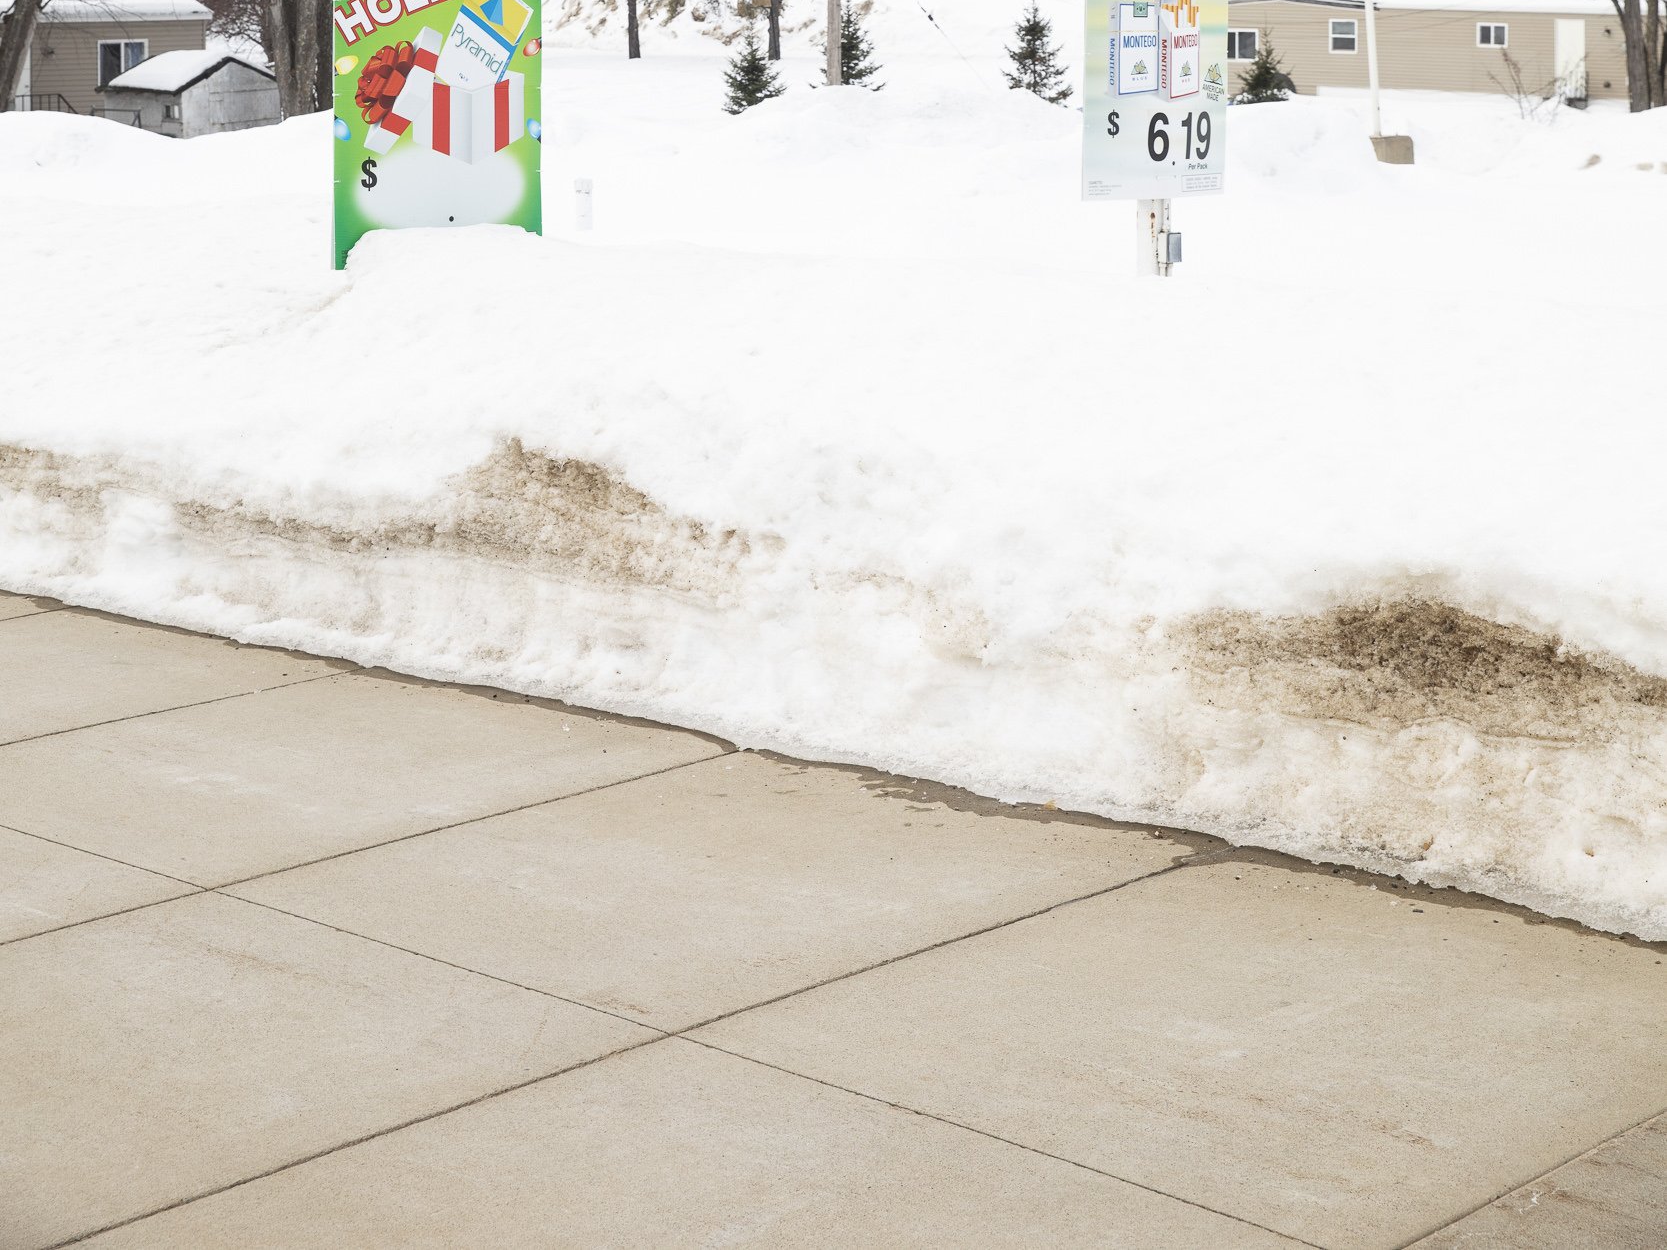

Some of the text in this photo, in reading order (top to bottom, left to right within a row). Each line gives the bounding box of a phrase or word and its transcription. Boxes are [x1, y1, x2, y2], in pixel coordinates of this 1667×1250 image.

[451, 23, 504, 74] Pyramid
[1123, 35, 1157, 48] MONTEGO
[1173, 34, 1198, 49] MONTEGO
[1202, 84, 1225, 95] AMERICAN
[1107, 109, 1120, 138] $
[361, 156, 378, 192] $
